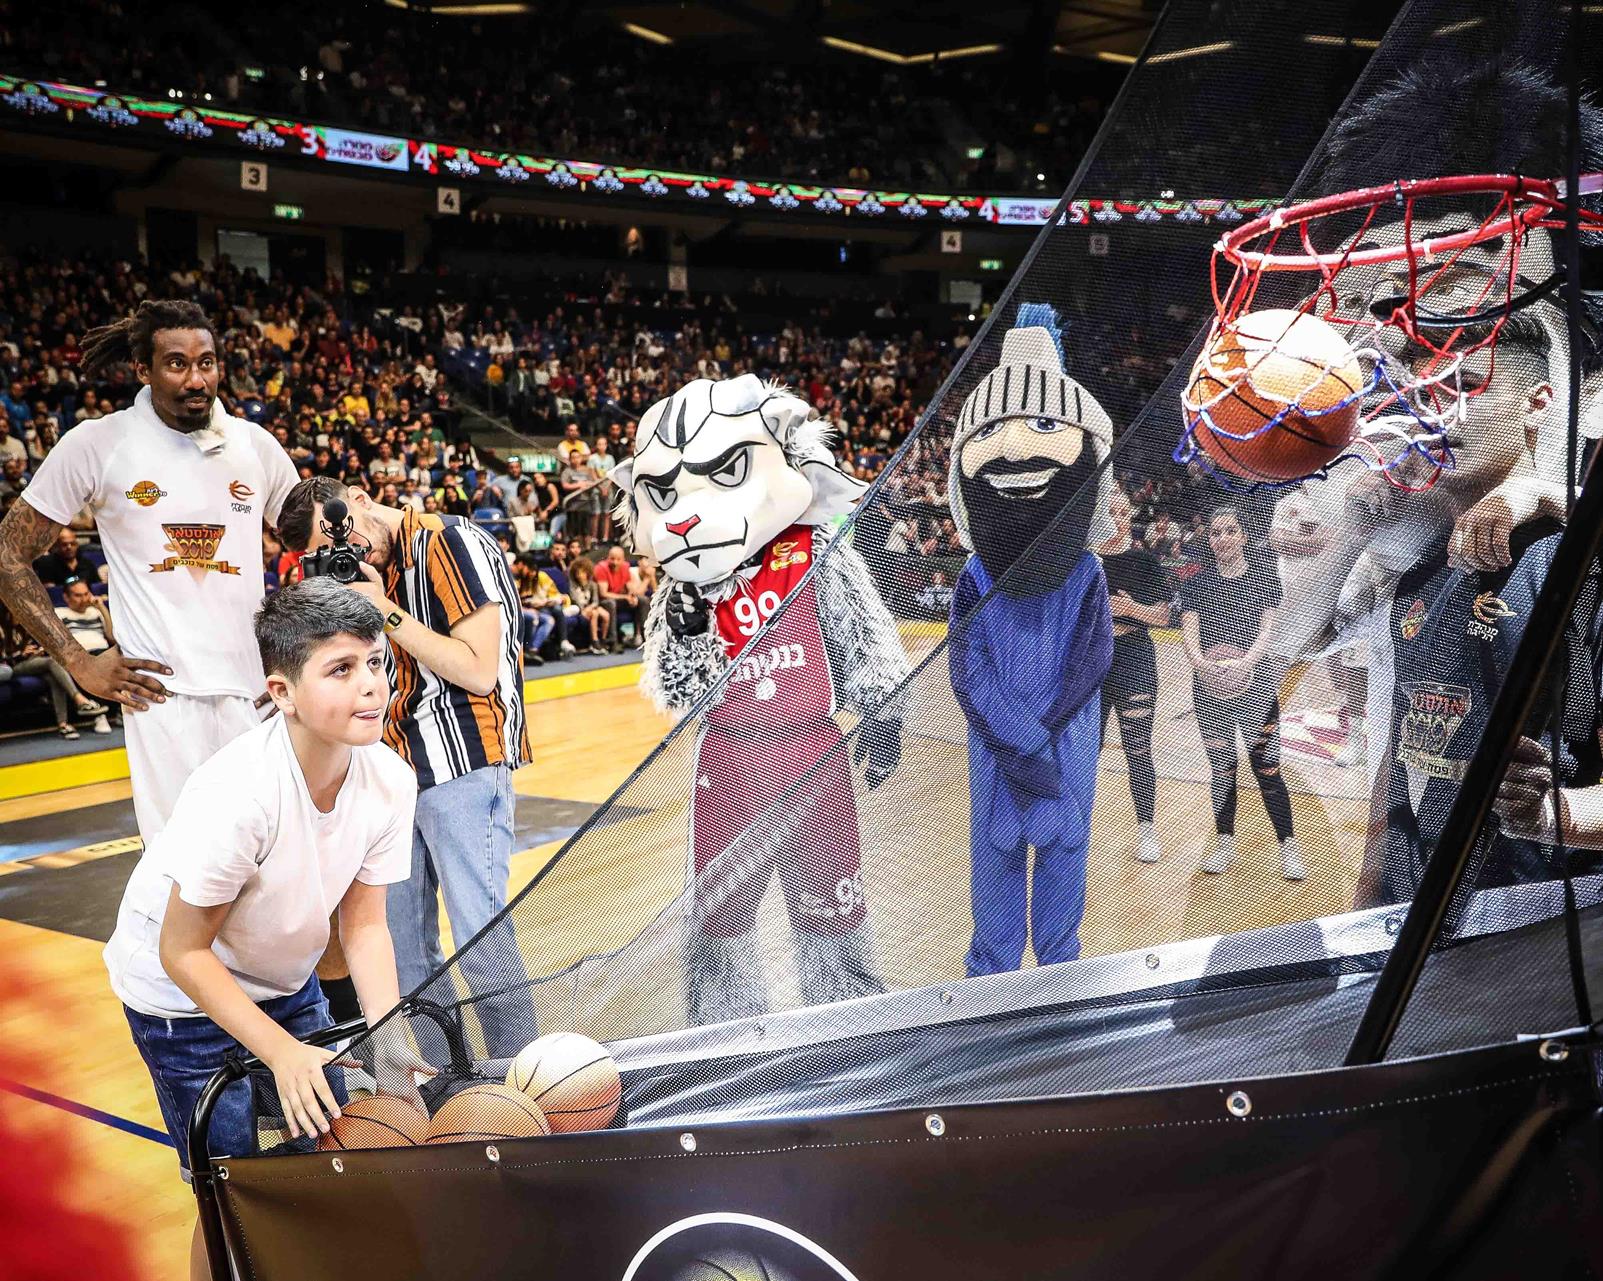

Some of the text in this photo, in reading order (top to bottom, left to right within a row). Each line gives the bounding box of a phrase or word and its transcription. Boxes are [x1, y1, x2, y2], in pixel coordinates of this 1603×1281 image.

[301, 127, 319, 155] 3
[413, 141, 432, 170] 4
[248, 167, 260, 186] 3
[443, 191, 455, 210] 4
[978, 198, 993, 221] 4
[1070, 201, 1084, 223] 5
[167, 528, 220, 540] אולסטאר
[179, 538, 214, 559] 2019
